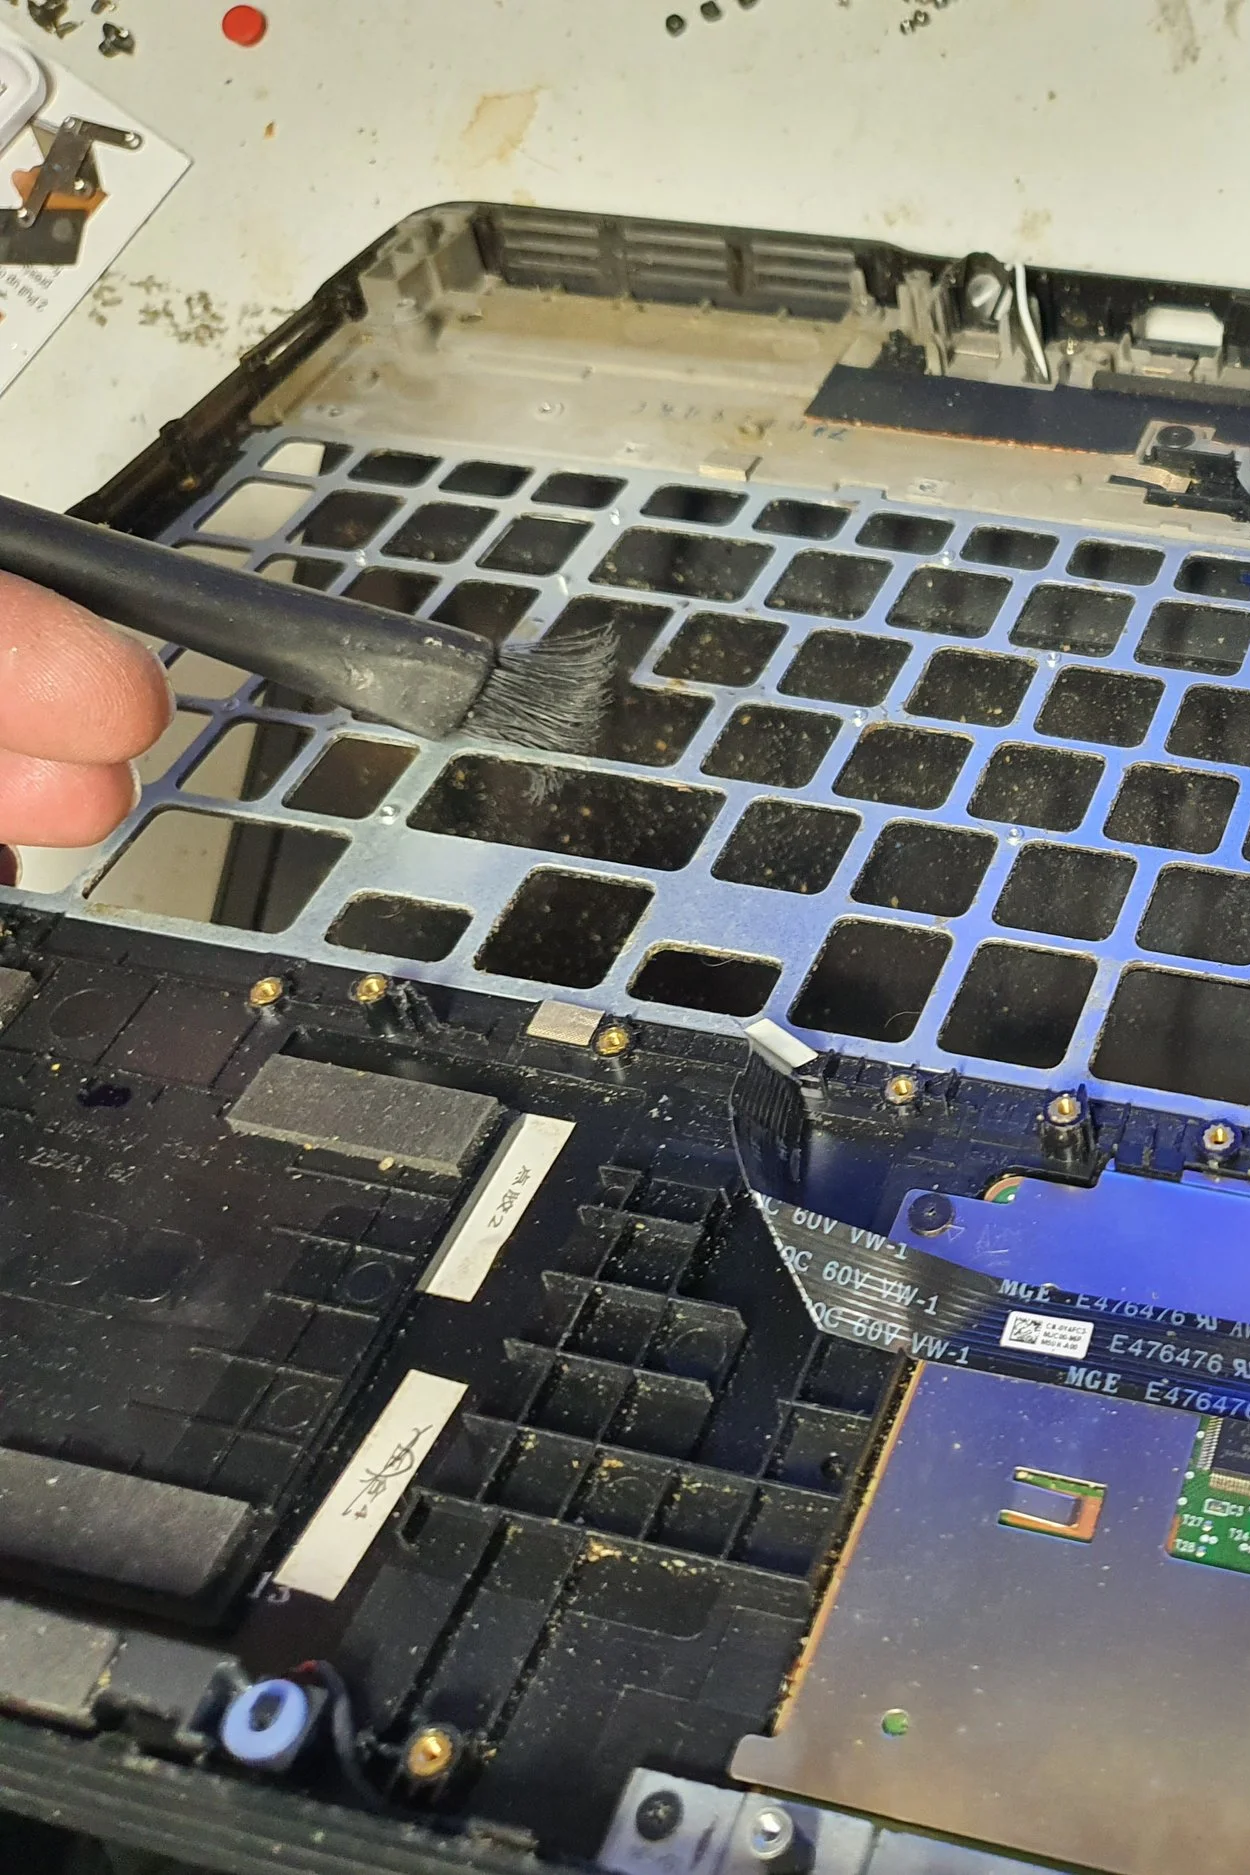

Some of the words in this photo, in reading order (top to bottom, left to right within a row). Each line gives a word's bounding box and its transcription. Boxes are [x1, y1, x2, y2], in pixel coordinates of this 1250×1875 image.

[851, 1226, 908, 1260] VW-1
[822, 1261, 870, 1290] 60V
[881, 1277, 939, 1315] VW-1
[998, 1279, 1051, 1302] MGE
[852, 1318, 901, 1345] 60V
[910, 1332, 971, 1365] VW-1
[1109, 1334, 1224, 1374] E476476
[1064, 1366, 1121, 1394] MGE
